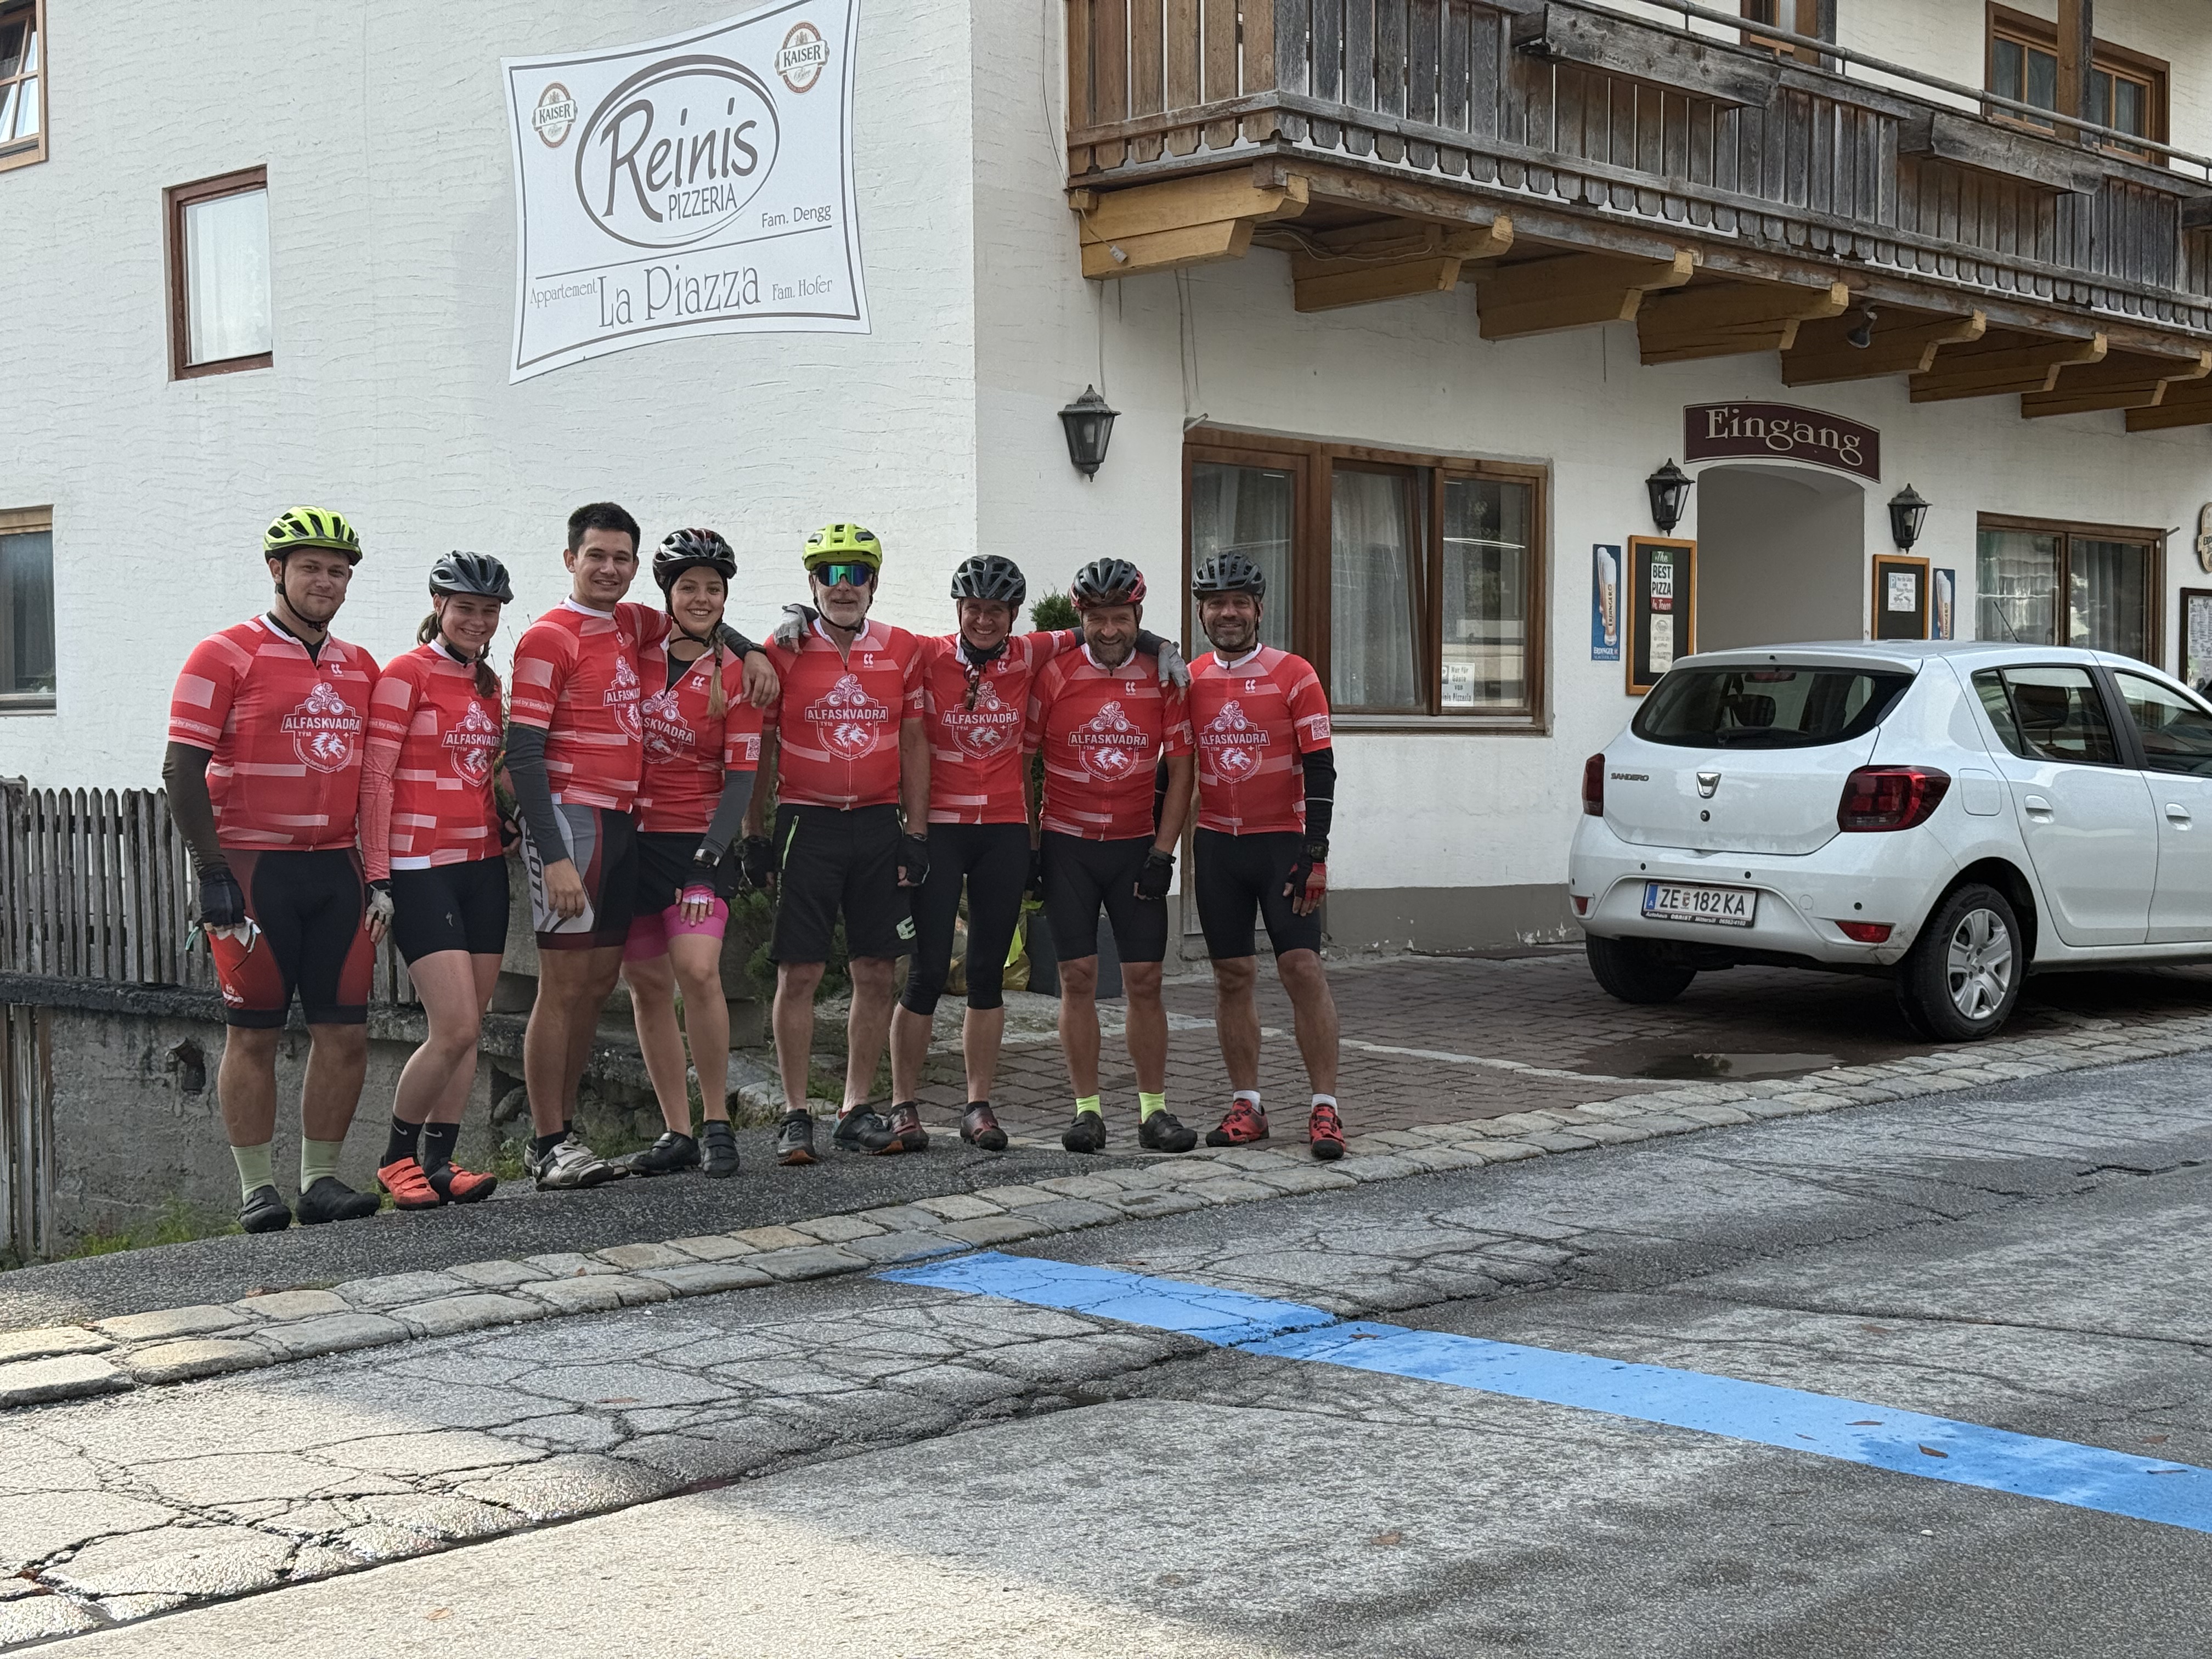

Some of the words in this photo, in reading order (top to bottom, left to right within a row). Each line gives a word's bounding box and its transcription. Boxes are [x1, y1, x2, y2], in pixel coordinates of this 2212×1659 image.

[783, 44, 821, 67] KAISER
[539, 103, 571, 124] KAISER
[600, 97, 758, 223] Reinis
[668, 183, 737, 221] PIZZERIA
[761, 212, 789, 228] Fam.
[793, 205, 832, 223] Dengg
[529, 278, 597, 308] Appartement
[597, 275, 634, 329] La
[644, 264, 761, 320] Piazza
[772, 283, 795, 301] Fam.
[798, 275, 833, 297] Hofer
[1705, 407, 1863, 466] Eingang
[1656, 551, 1668, 563] The
[1652, 565, 1672, 579] BEST
[1652, 581, 1672, 595] PIZZA
[807, 709, 886, 720] ALFASKVADRA
[945, 711, 1018, 724] ALFASKVADRA
[285, 716, 360, 731] ALFASKVADRA
[1070, 734, 1147, 746] ALFASKVADRA
[1201, 733, 1267, 744] ALFASKVADRA
[1611, 772, 1650, 782] SANDERO
[1660, 888, 1681, 909] ZE
[1693, 891, 1721, 913] 182
[1723, 893, 1745, 916] KA
